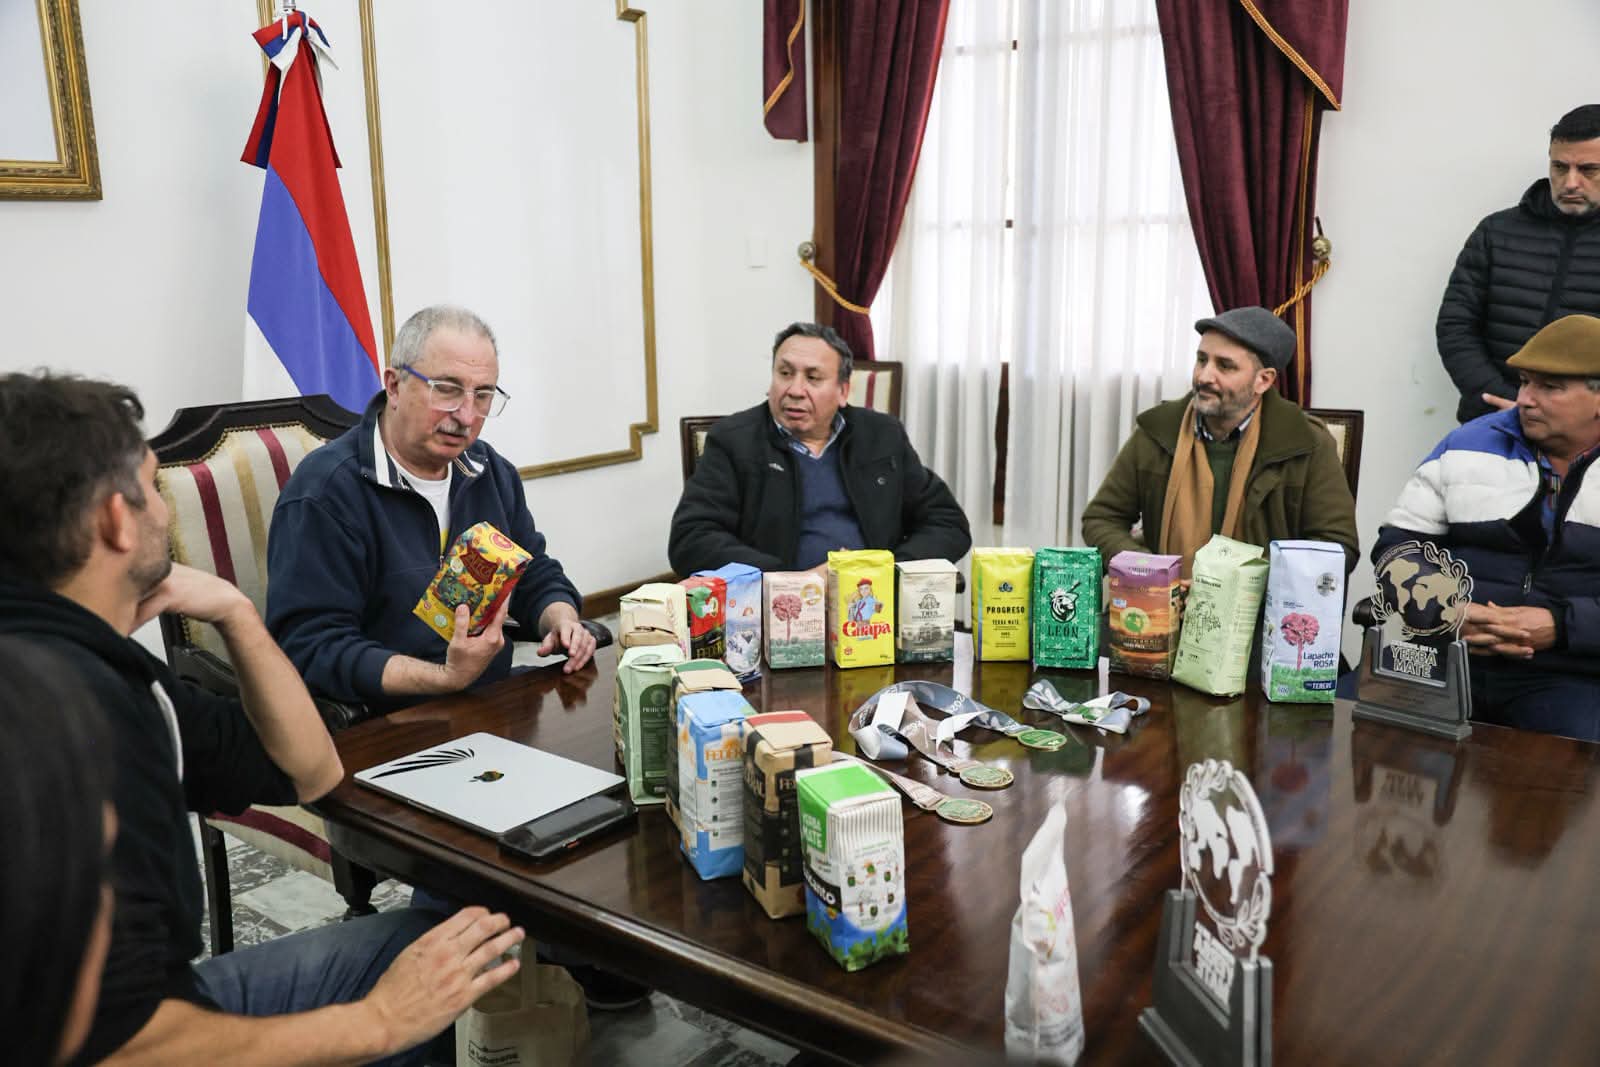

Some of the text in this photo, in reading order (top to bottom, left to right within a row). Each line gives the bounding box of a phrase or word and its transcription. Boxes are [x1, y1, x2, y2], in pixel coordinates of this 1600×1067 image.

[986, 606, 1024, 614] PROGRESO
[843, 621, 891, 640] Guapa
[1303, 651, 1334, 660] Lapacho
[1391, 645, 1437, 667] YERBA
[1313, 660, 1334, 668] ROSA
[1393, 658, 1431, 679] MATE
